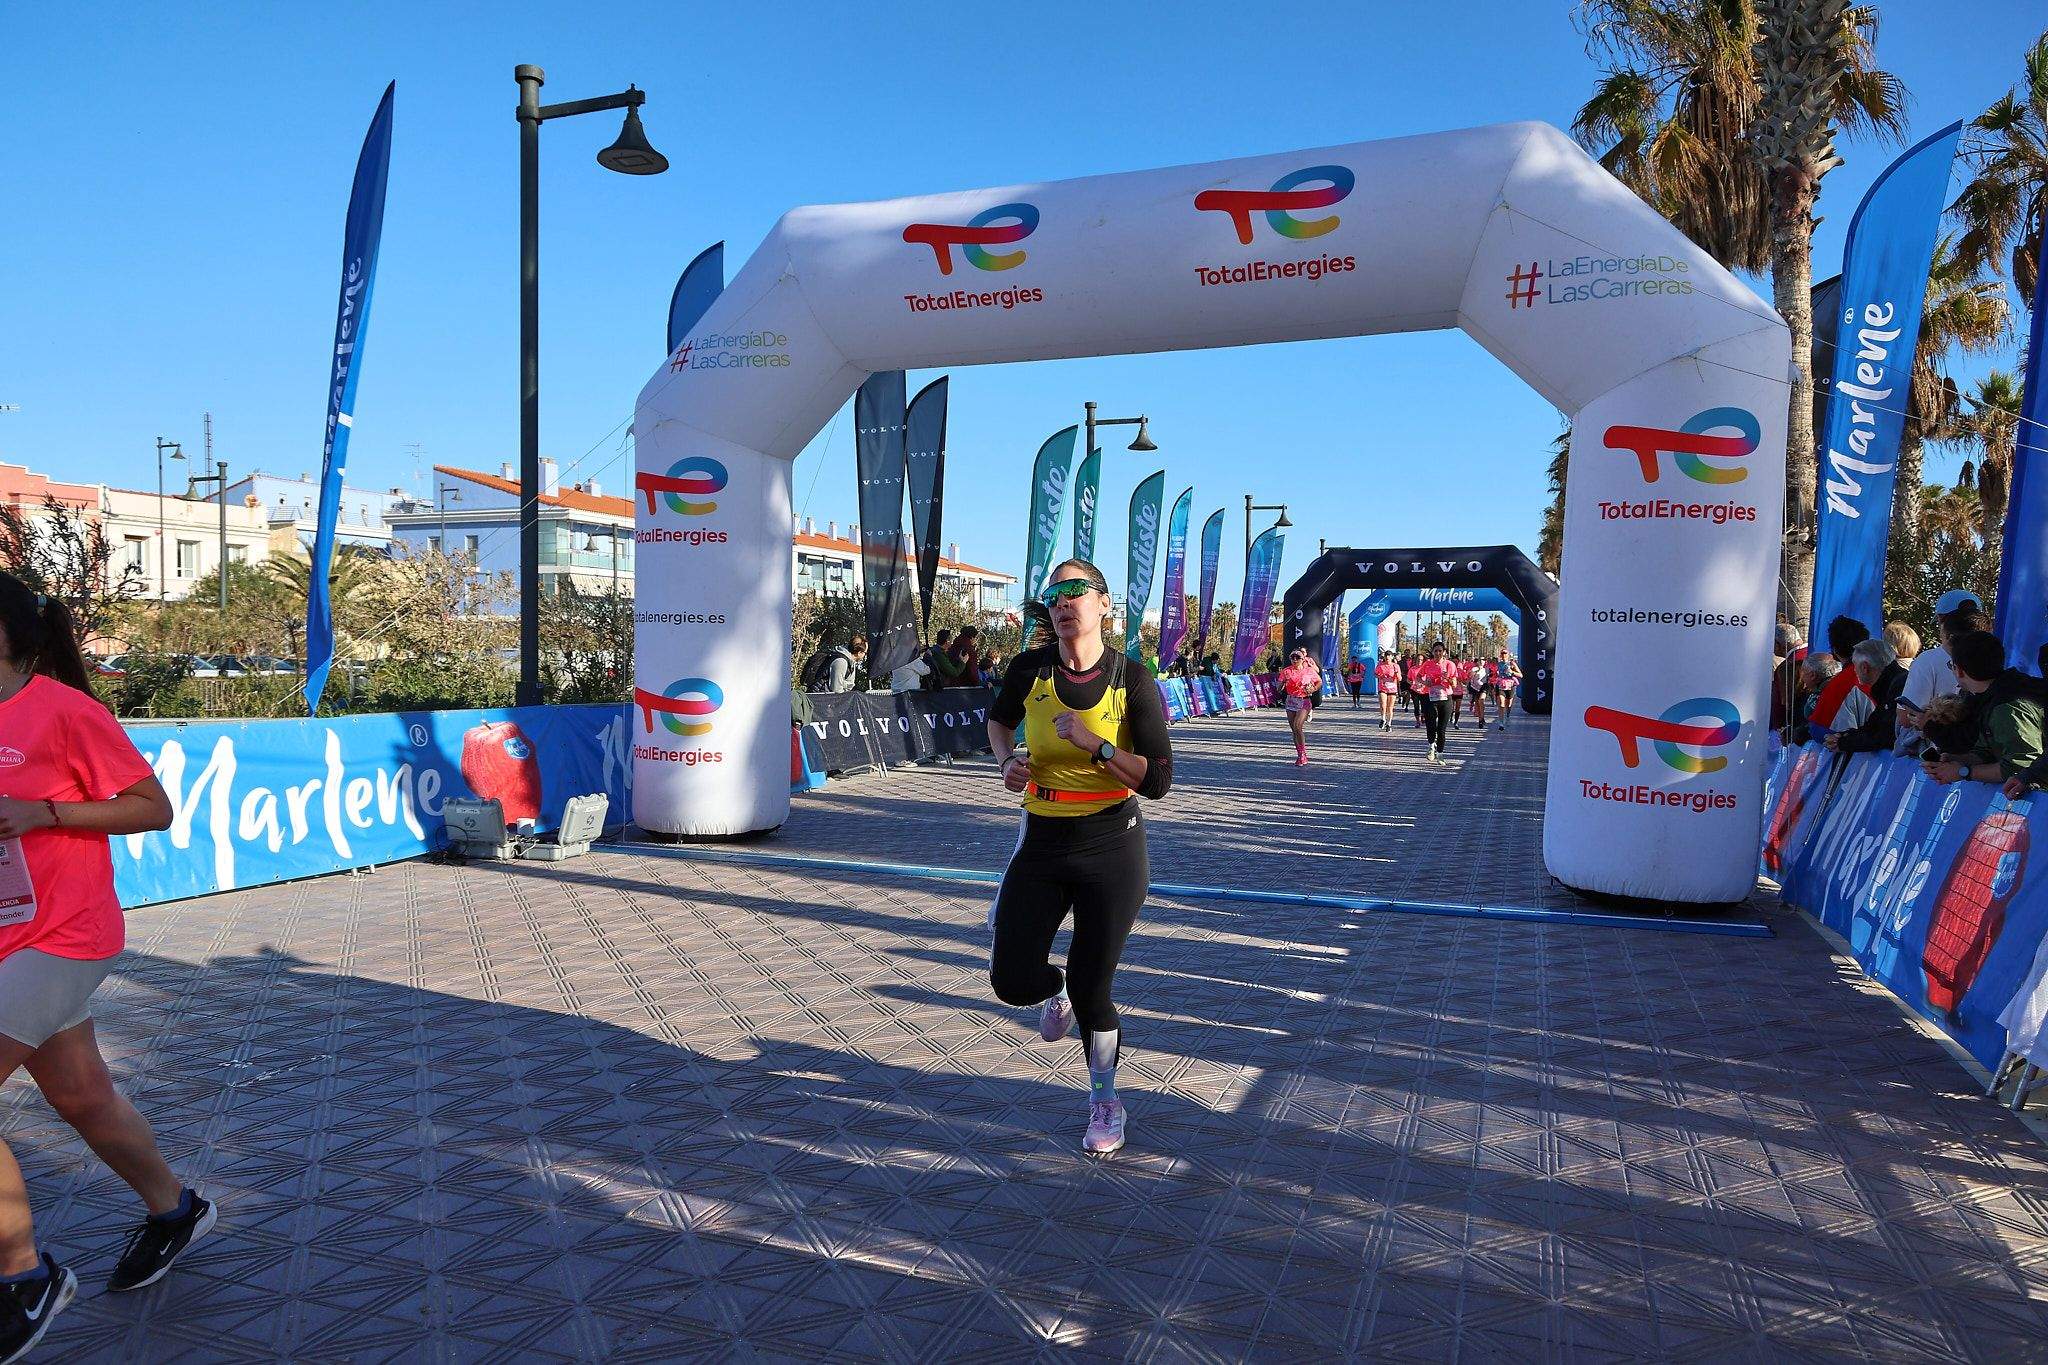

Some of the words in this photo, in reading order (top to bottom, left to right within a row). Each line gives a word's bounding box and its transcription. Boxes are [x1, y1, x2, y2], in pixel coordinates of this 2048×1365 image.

[1195, 253, 1357, 288] TotalEnergies
[904, 285, 1043, 313] TotalEnergies
[1548, 277, 1693, 305] LasCarreras
[690, 351, 791, 370] LasCarreras
[1825, 301, 1902, 519] Marlene
[863, 477, 902, 485] VOLV
[1598, 500, 1757, 525] TotalEnergies
[635, 527, 729, 546] otalEnergies
[1128, 503, 1158, 617] Batiste
[1355, 560, 1483, 573] VOLVO
[1419, 587, 1474, 605] Marlene
[634, 611, 726, 626] talenergies.es
[1590, 607, 1749, 629] totalenergies.es
[1537, 610, 1547, 700] VOLVO
[810, 715, 910, 740] VOLVO
[923, 708, 986, 730] VOLV
[633, 744, 723, 766] otalEnergies
[1579, 779, 1737, 812] TotalEnergies
[126, 727, 445, 891] Marlene
